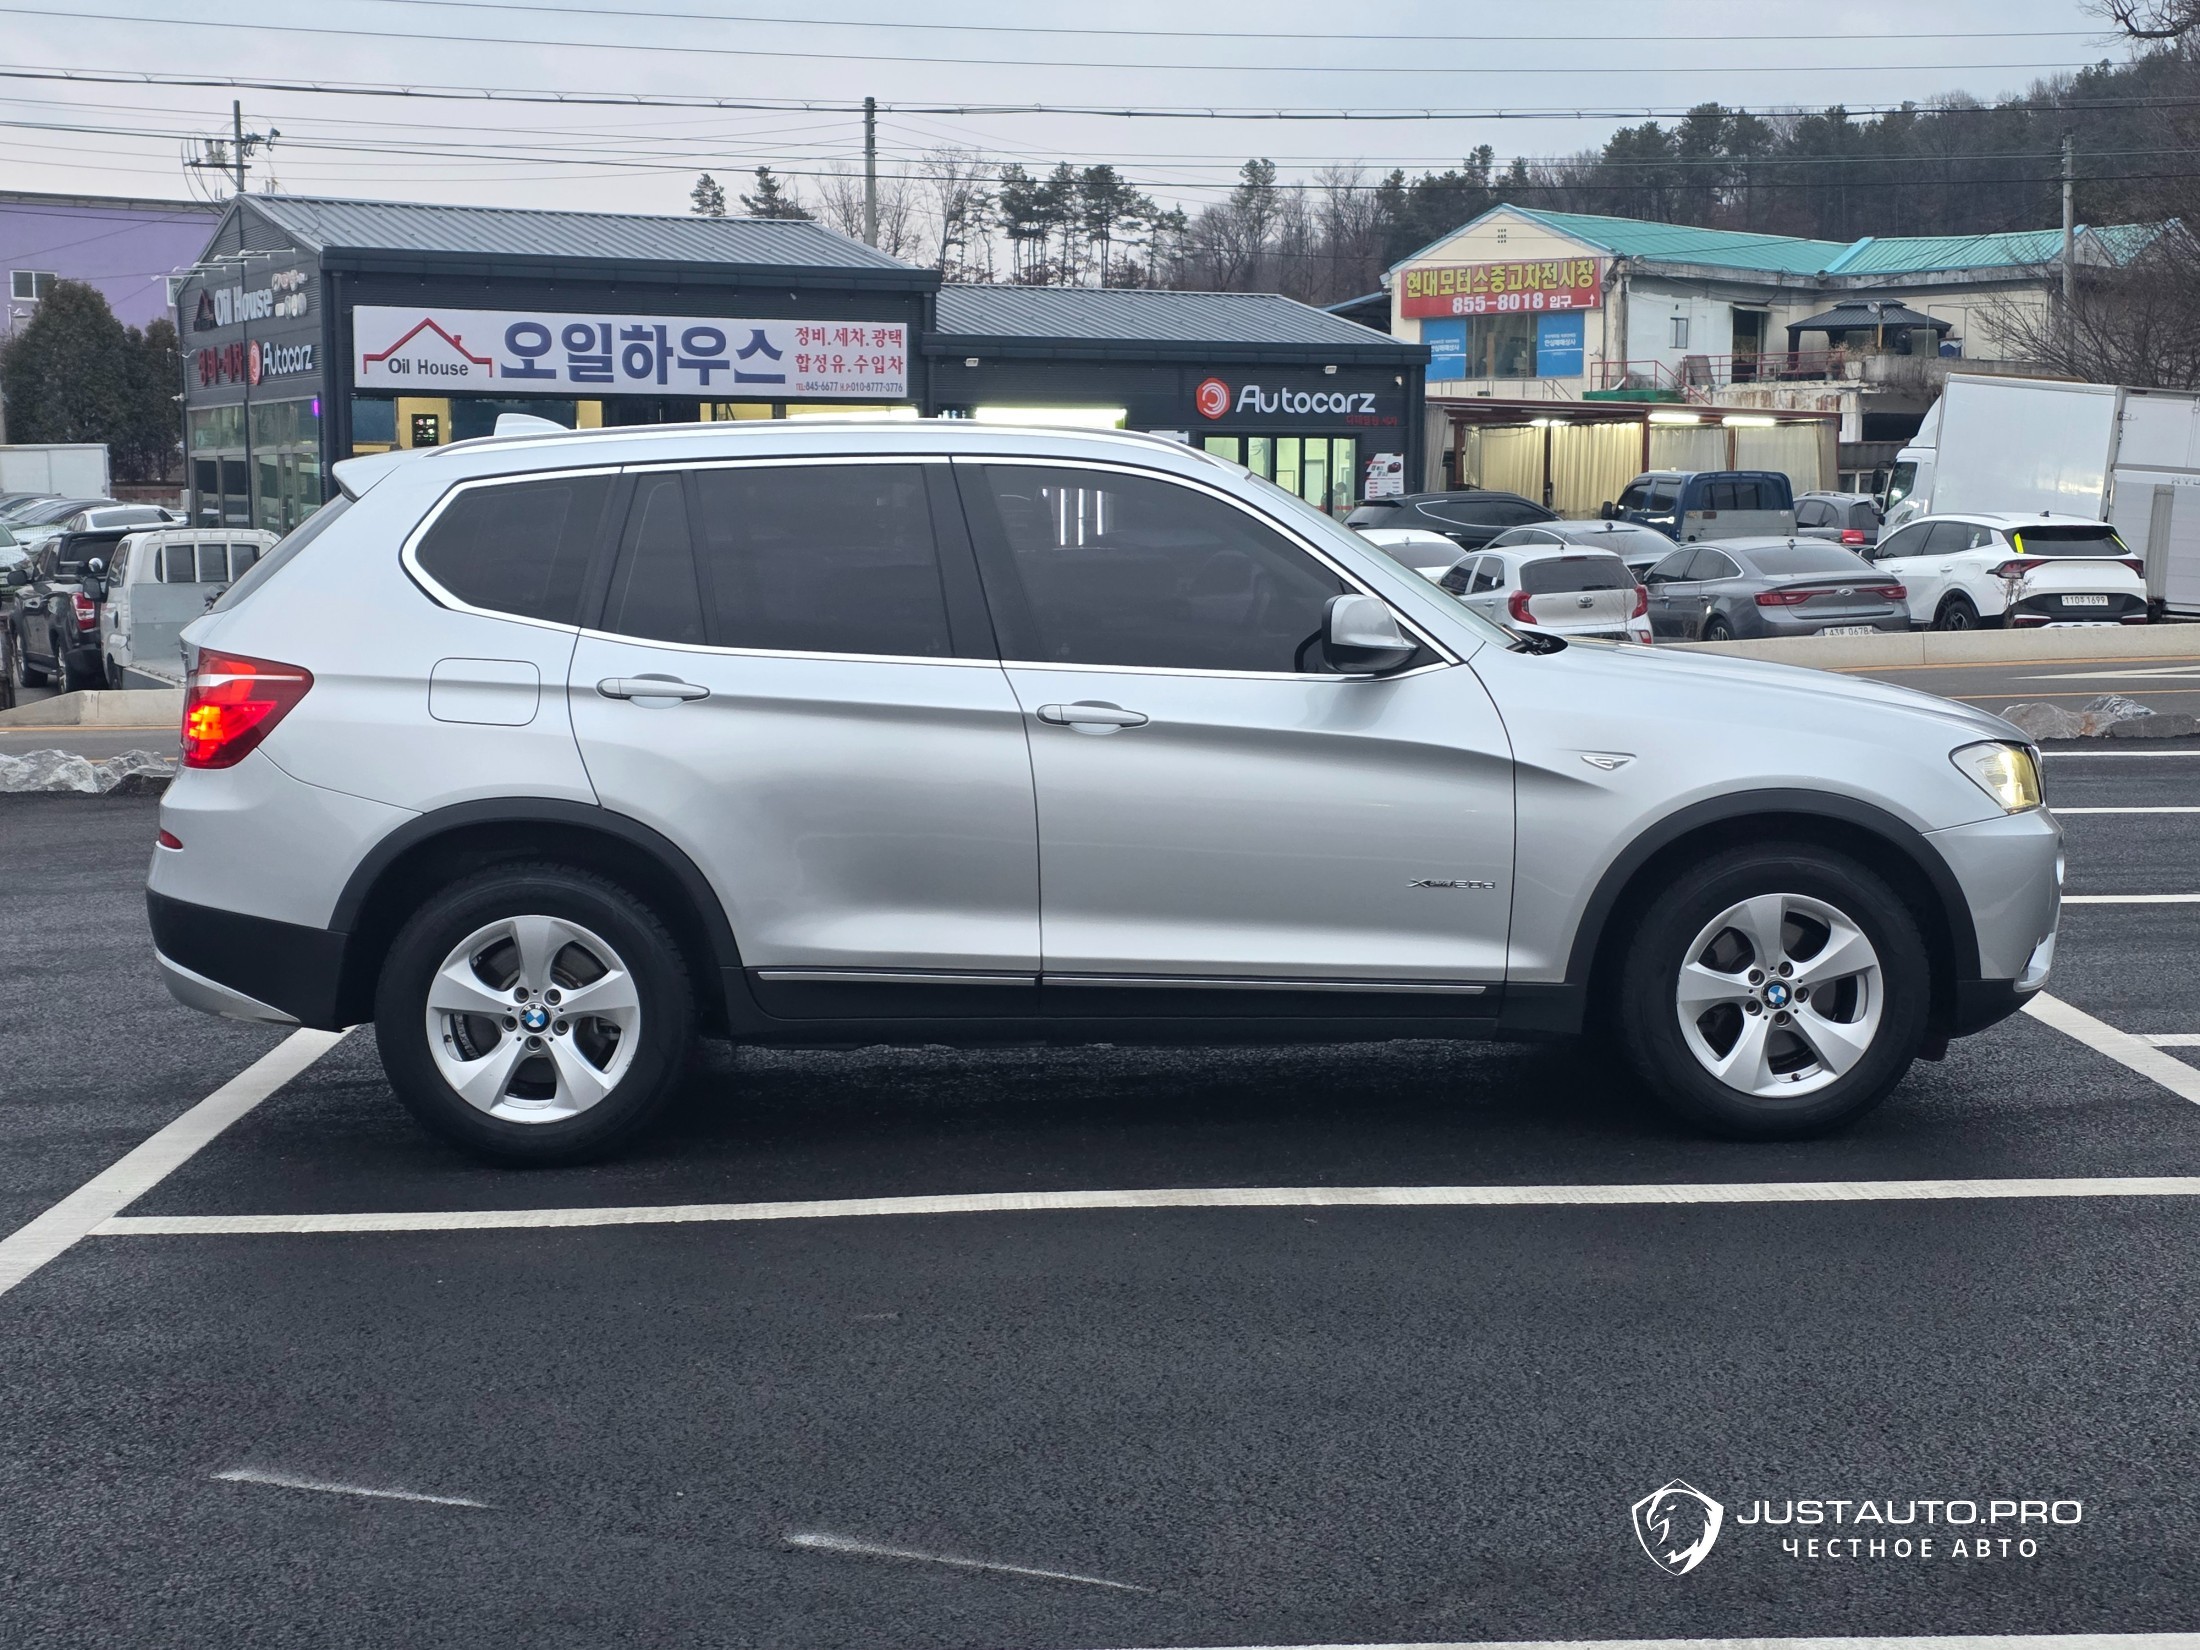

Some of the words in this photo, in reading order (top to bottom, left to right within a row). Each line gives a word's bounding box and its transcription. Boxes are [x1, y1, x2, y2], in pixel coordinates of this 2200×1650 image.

[1406, 258, 1595, 298] 현대모터스중고차전시장
[214, 288, 232, 326] Oil
[233, 285, 273, 322] House
[1452, 292, 1544, 314] 855-8018
[1549, 295, 1572, 308] 입구
[262, 341, 313, 376] Autocarz
[500, 321, 786, 386] 오일하우스
[388, 357, 410, 374] Oil
[417, 359, 469, 376] House
[1235, 385, 1376, 414] Autocarz
[2086, 596, 2106, 604] 1699
[1848, 626, 1869, 636] 0678
